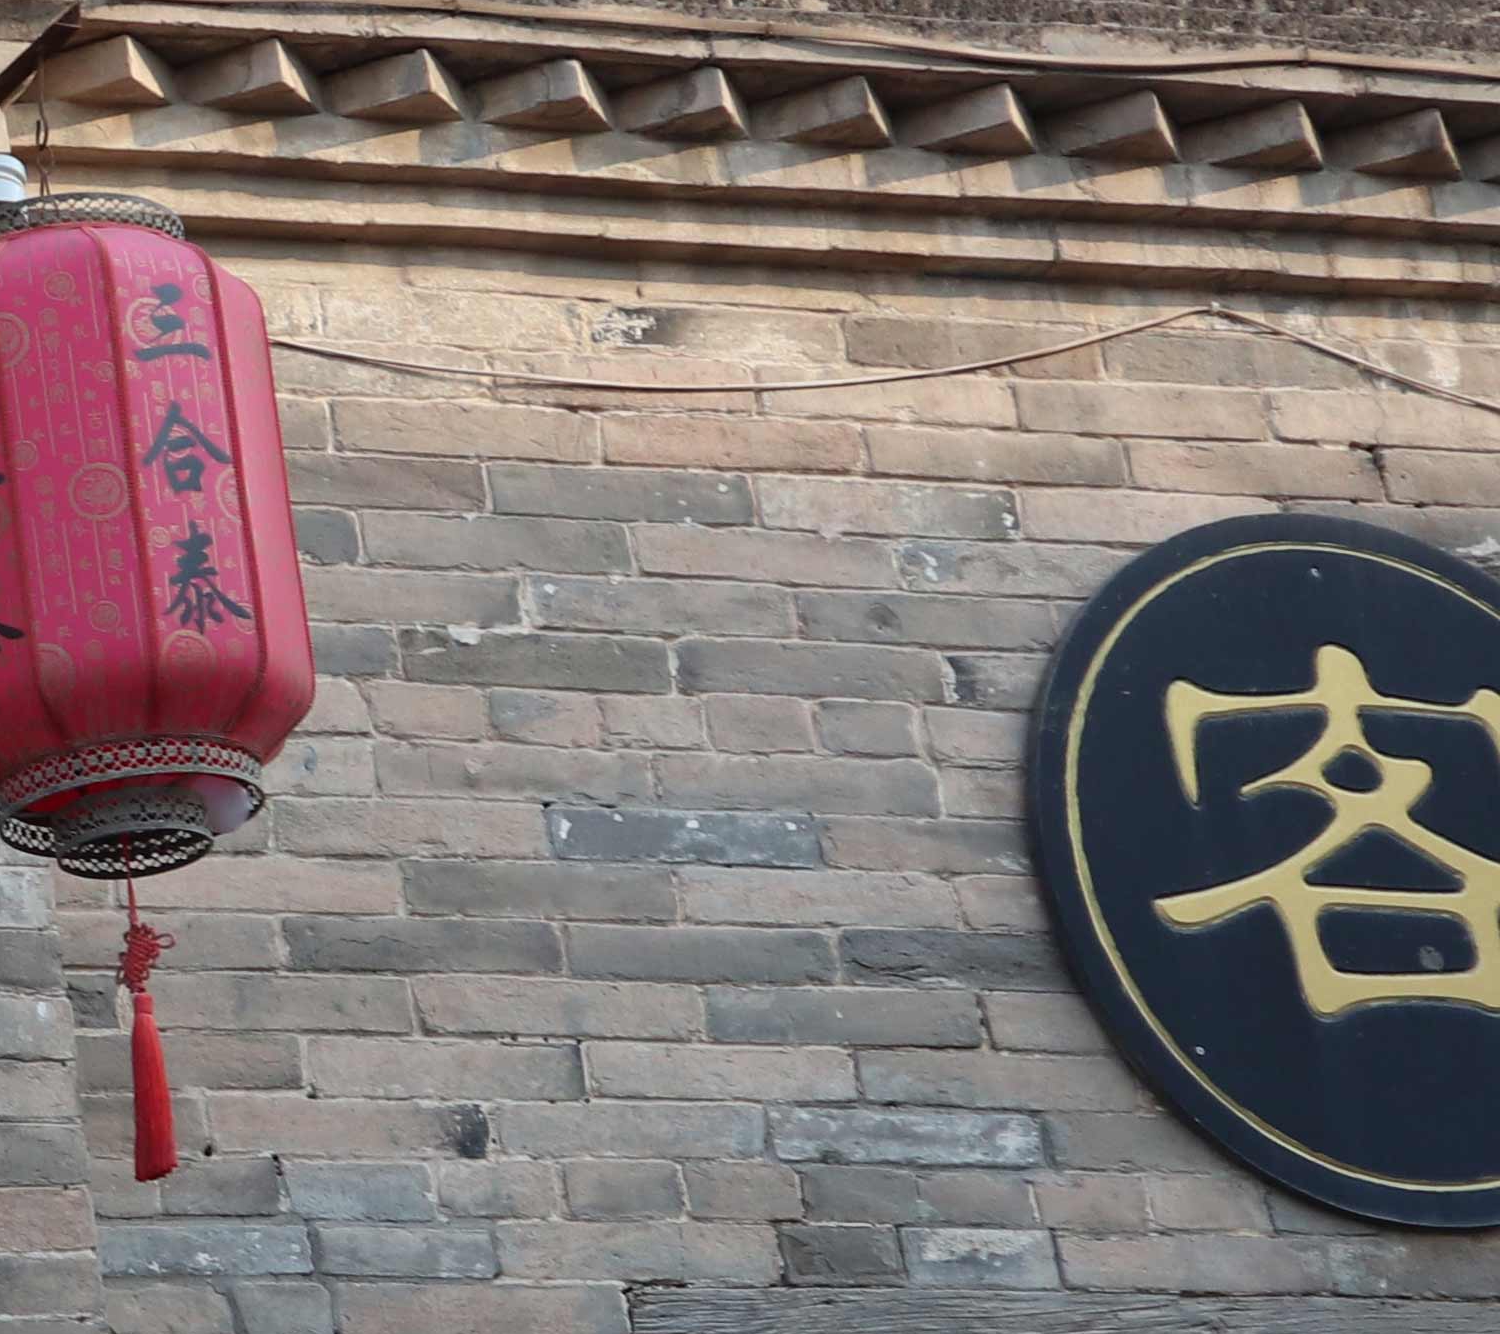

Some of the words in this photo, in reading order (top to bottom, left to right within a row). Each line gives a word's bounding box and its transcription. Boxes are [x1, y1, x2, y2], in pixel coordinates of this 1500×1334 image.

[135, 282, 253, 636] 三合泰
[1153, 643, 1500, 1021] 客
